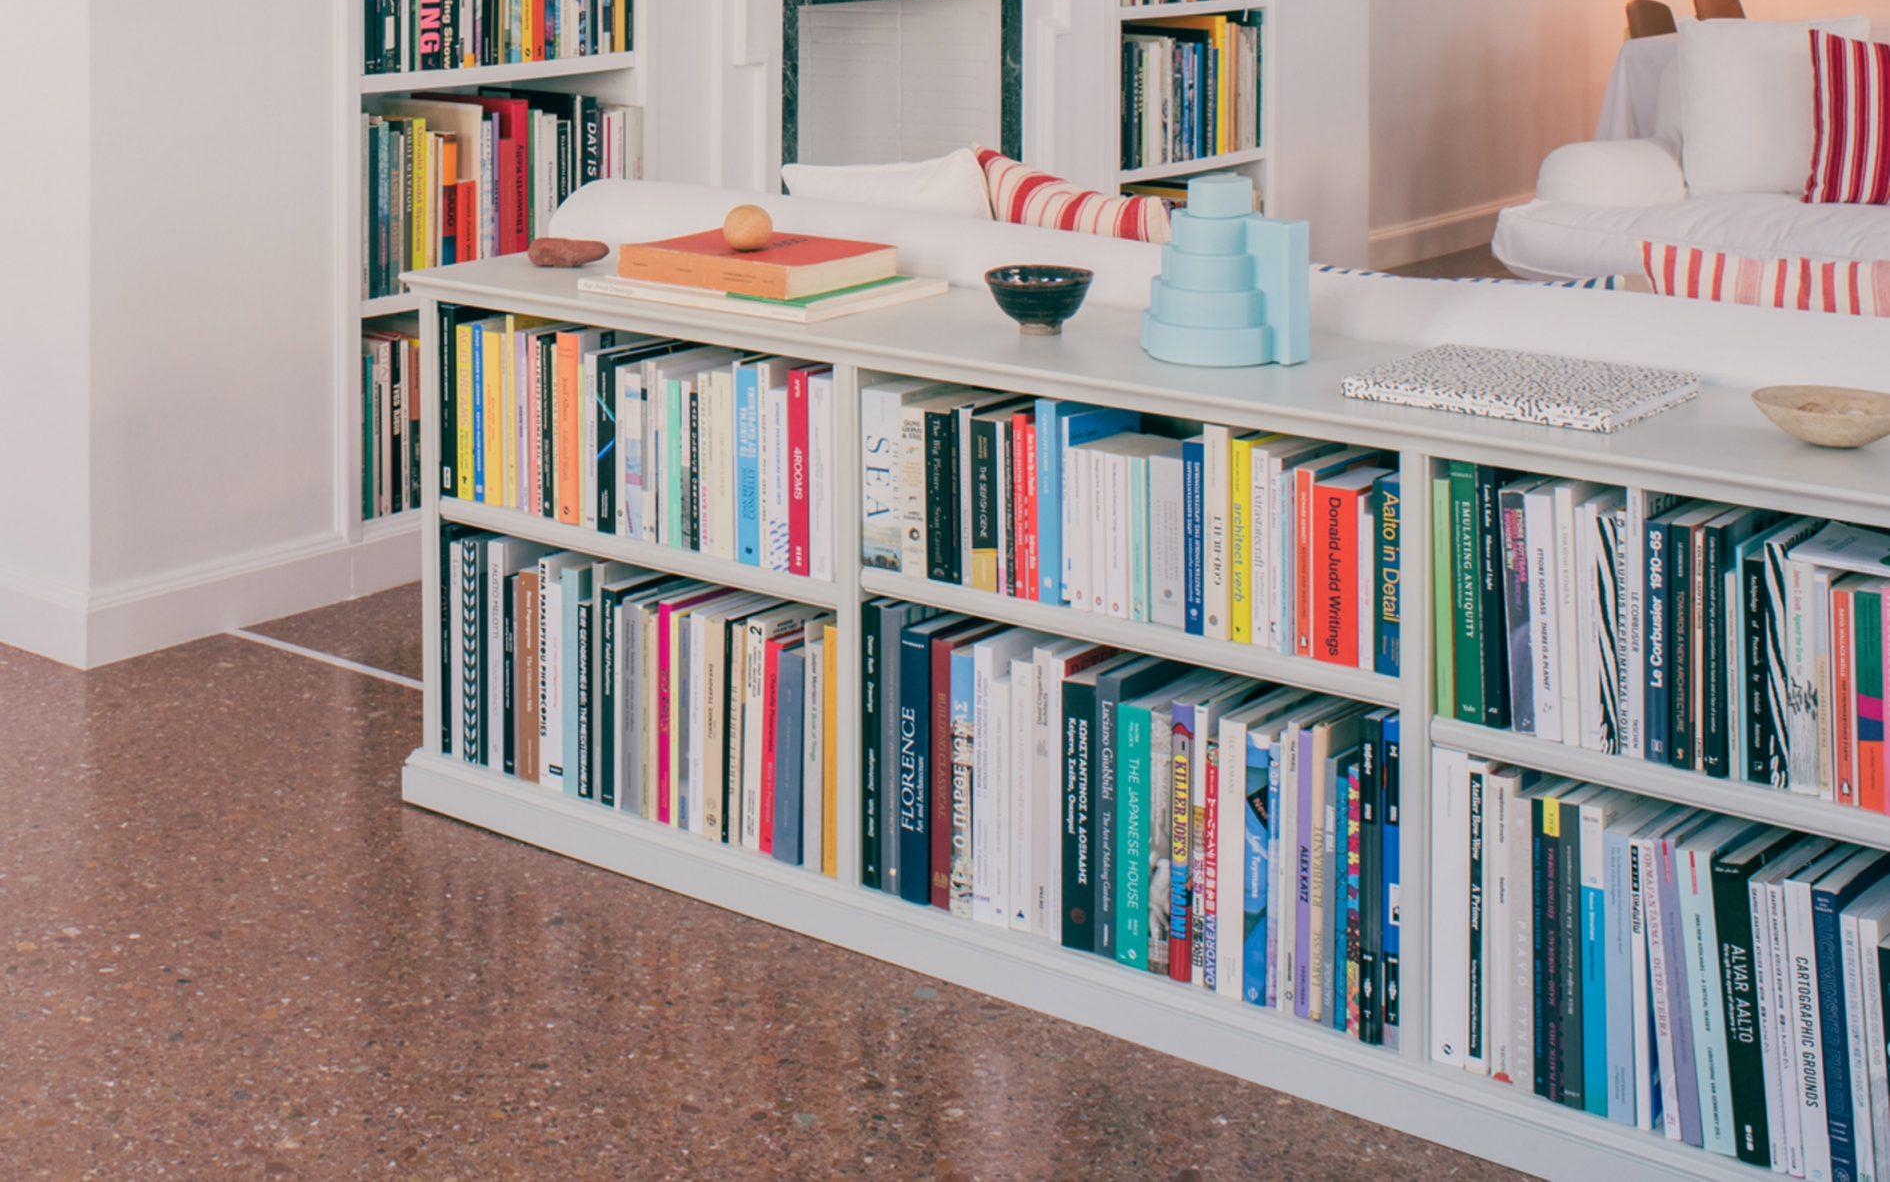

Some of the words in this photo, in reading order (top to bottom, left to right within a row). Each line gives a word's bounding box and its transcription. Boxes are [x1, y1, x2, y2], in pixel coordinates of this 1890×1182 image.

[443, 27, 453, 70] Show
[587, 122, 597, 154] DAY
[588, 160, 597, 176] IS
[932, 418, 940, 436] The
[932, 439, 940, 455] Big
[748, 468, 756, 520] CONNELLY
[794, 447, 802, 500] 4ROOMS
[866, 436, 891, 518] SEA
[933, 457, 942, 491] Picture
[980, 466, 988, 480] THE
[934, 506, 942, 528] Sean
[980, 483, 988, 512] SELFISH
[1382, 492, 1400, 540] Aalto
[980, 514, 988, 538] GENE
[1234, 502, 1245, 564] architect
[1254, 485, 1265, 568] Extrastatecraft
[1329, 497, 1342, 550] Donald
[1462, 501, 1472, 568] EMULATING
[1618, 538, 1624, 546] A
[934, 531, 943, 563] Carroll
[1382, 545, 1400, 562] in
[1506, 551, 1514, 569] WHY
[1650, 531, 1662, 589] 1910-65
[1234, 570, 1244, 602] verb
[1329, 553, 1342, 592] Judd
[1618, 552, 1626, 608] BAUHAUS
[1794, 570, 1803, 588] James
[1382, 568, 1400, 622] Detail
[1464, 574, 1474, 638] ANTIQUITY
[1632, 592, 1639, 603] LE
[1676, 591, 1684, 634] TOWARDS
[1794, 596, 1804, 610] Scott
[1326, 595, 1342, 656] Writings
[1538, 578, 1546, 615] SOTTSASS
[1542, 661, 1550, 690] PLANET
[1650, 596, 1662, 666] Corbusier
[1752, 620, 1760, 628] of
[1794, 614, 1804, 636] Against
[1796, 638, 1804, 646] the
[866, 636, 874, 655] Dieter
[866, 658, 874, 674] Roth
[1619, 613, 1628, 704] EXPERIMENTAL
[1676, 643, 1684, 662] NEW
[1752, 636, 1760, 666] Protocols
[1796, 648, 1804, 663] Grain
[866, 682, 874, 712] Drawings
[1650, 668, 1662, 688] Le
[1676, 664, 1684, 732] ARCHITECTURE
[1751, 674, 1761, 682] by
[938, 693, 948, 750] BUILDING
[1102, 700, 1112, 746] Luciano
[1620, 710, 1628, 749] HOUSE
[868, 748, 876, 791] Zeichnungen
[902, 708, 916, 831] FLORENCE
[953, 700, 968, 827] ΠΑΡΘΕΝΩΝΑΣ
[1078, 720, 1087, 811] ΚΩΝΣΤΑΝΤΙΝΟΣ
[1102, 748, 1112, 800] Giubbilei
[1128, 758, 1140, 784] THE
[938, 754, 948, 819] CLASSICAL
[1174, 760, 1186, 815] KILLER
[1470, 780, 1482, 815] Atelier
[1128, 787, 1140, 855] JAPANESE
[1174, 816, 1186, 856] JOE'S
[1470, 816, 1482, 860] Bow-Wow
[1078, 826, 1087, 884] ΔΟΞΙΑΔΗΣ
[1101, 851, 1110, 879] Making
[1300, 845, 1309, 872] ALEX
[1102, 881, 1110, 912] Gardens
[1127, 860, 1140, 910] HOUSE
[1250, 856, 1260, 898] Tuymans
[1300, 875, 1309, 903] KATZ
[1471, 884, 1481, 893] A
[1644, 846, 1658, 946] FORMAFANTASMA
[1471, 896, 1481, 930] Primer
[1516, 919, 1527, 987] PAAVO
[1730, 944, 1749, 990] ALVAR
[1654, 958, 1664, 994] OLTRE
[1817, 914, 1839, 1045] BUCKMINSTER
[1657, 1000, 1667, 1036] TERRA
[1736, 998, 1753, 1043] AALTO
[1795, 956, 1814, 1046] CARTOGRAPHIC
[1517, 1005, 1528, 1078] TYNELL
[1802, 1052, 1819, 1108] GROUNDS
[1827, 1048, 1844, 1114] FULLER
